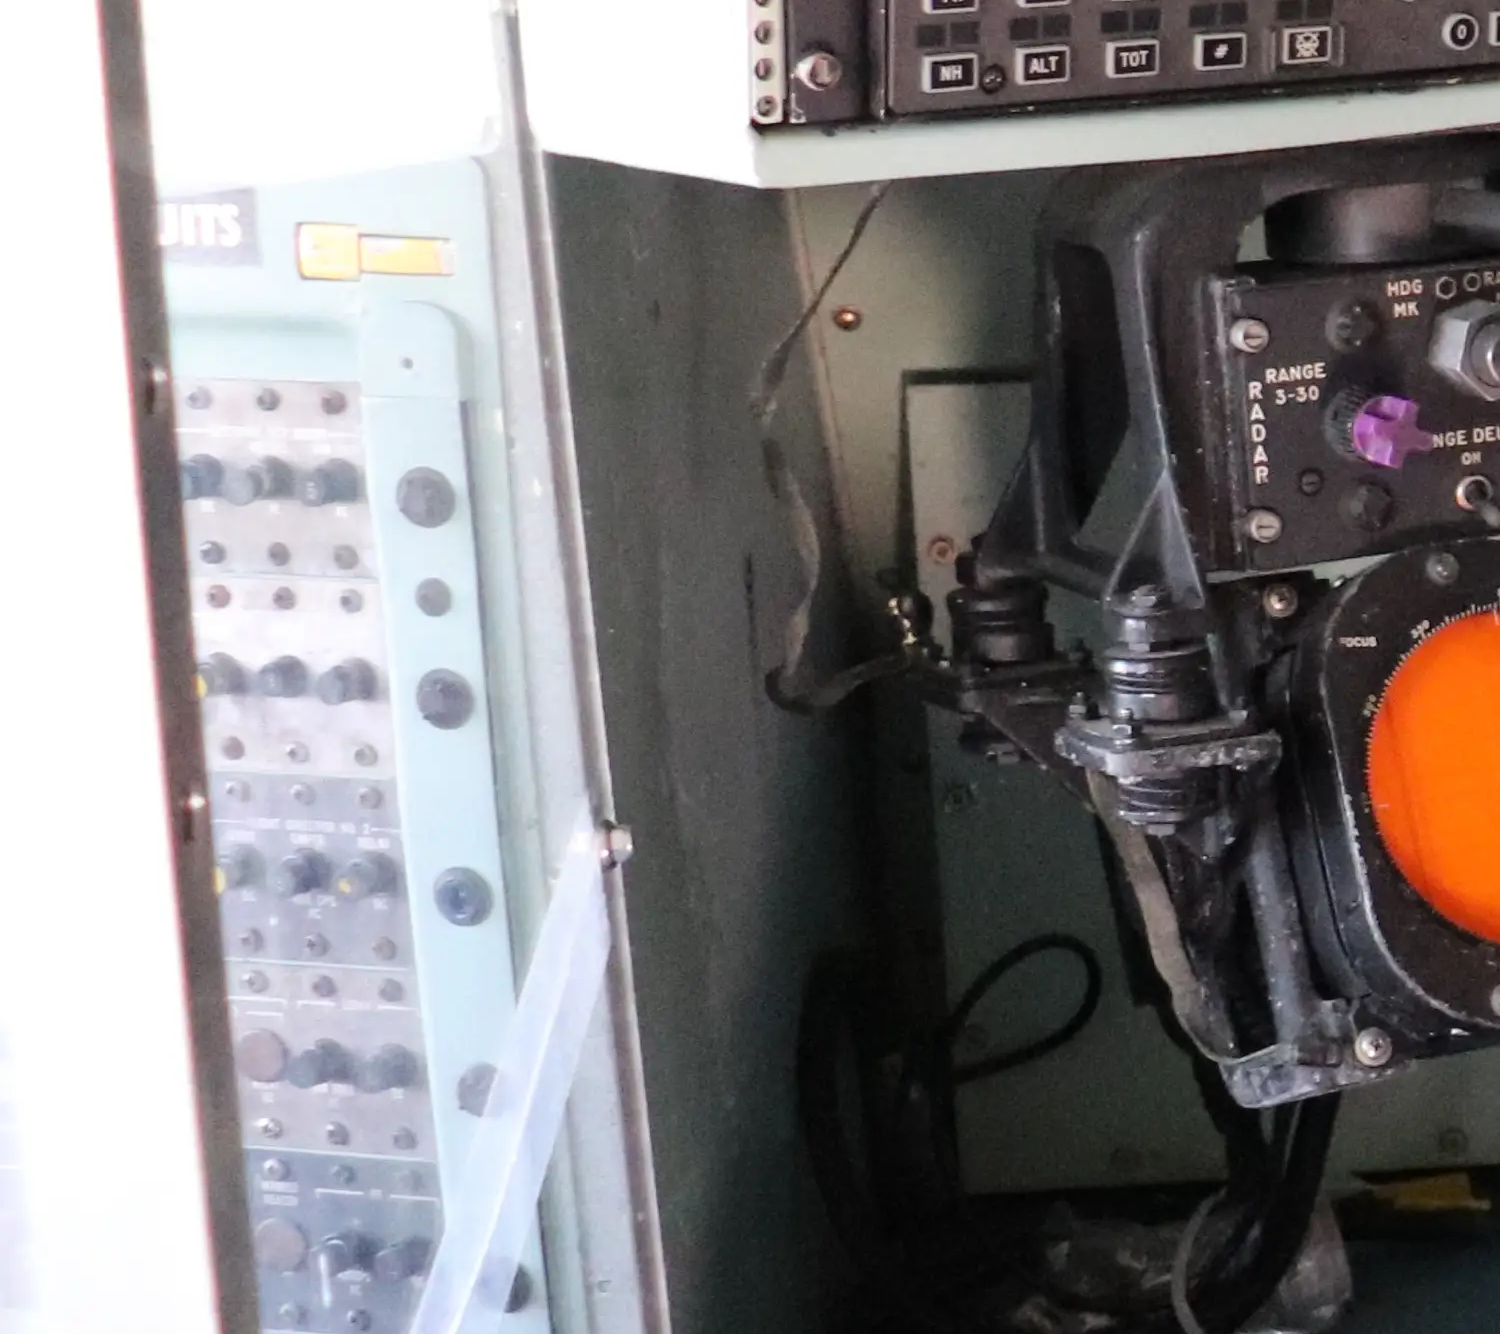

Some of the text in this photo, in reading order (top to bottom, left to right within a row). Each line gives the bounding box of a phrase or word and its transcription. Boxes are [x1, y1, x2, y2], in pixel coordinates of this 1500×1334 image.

[940, 65, 963, 82] NH
[1028, 56, 1060, 75] ALT
[1387, 278, 1423, 297] HDG
[1394, 301, 1420, 318] MK
[1265, 362, 1327, 384] RANGE
[1275, 385, 1320, 405] 3-30
[1249, 380, 1270, 486] RADAR
[1460, 449, 1482, 467] ON
[1339, 636, 1377, 648] FOCUS
